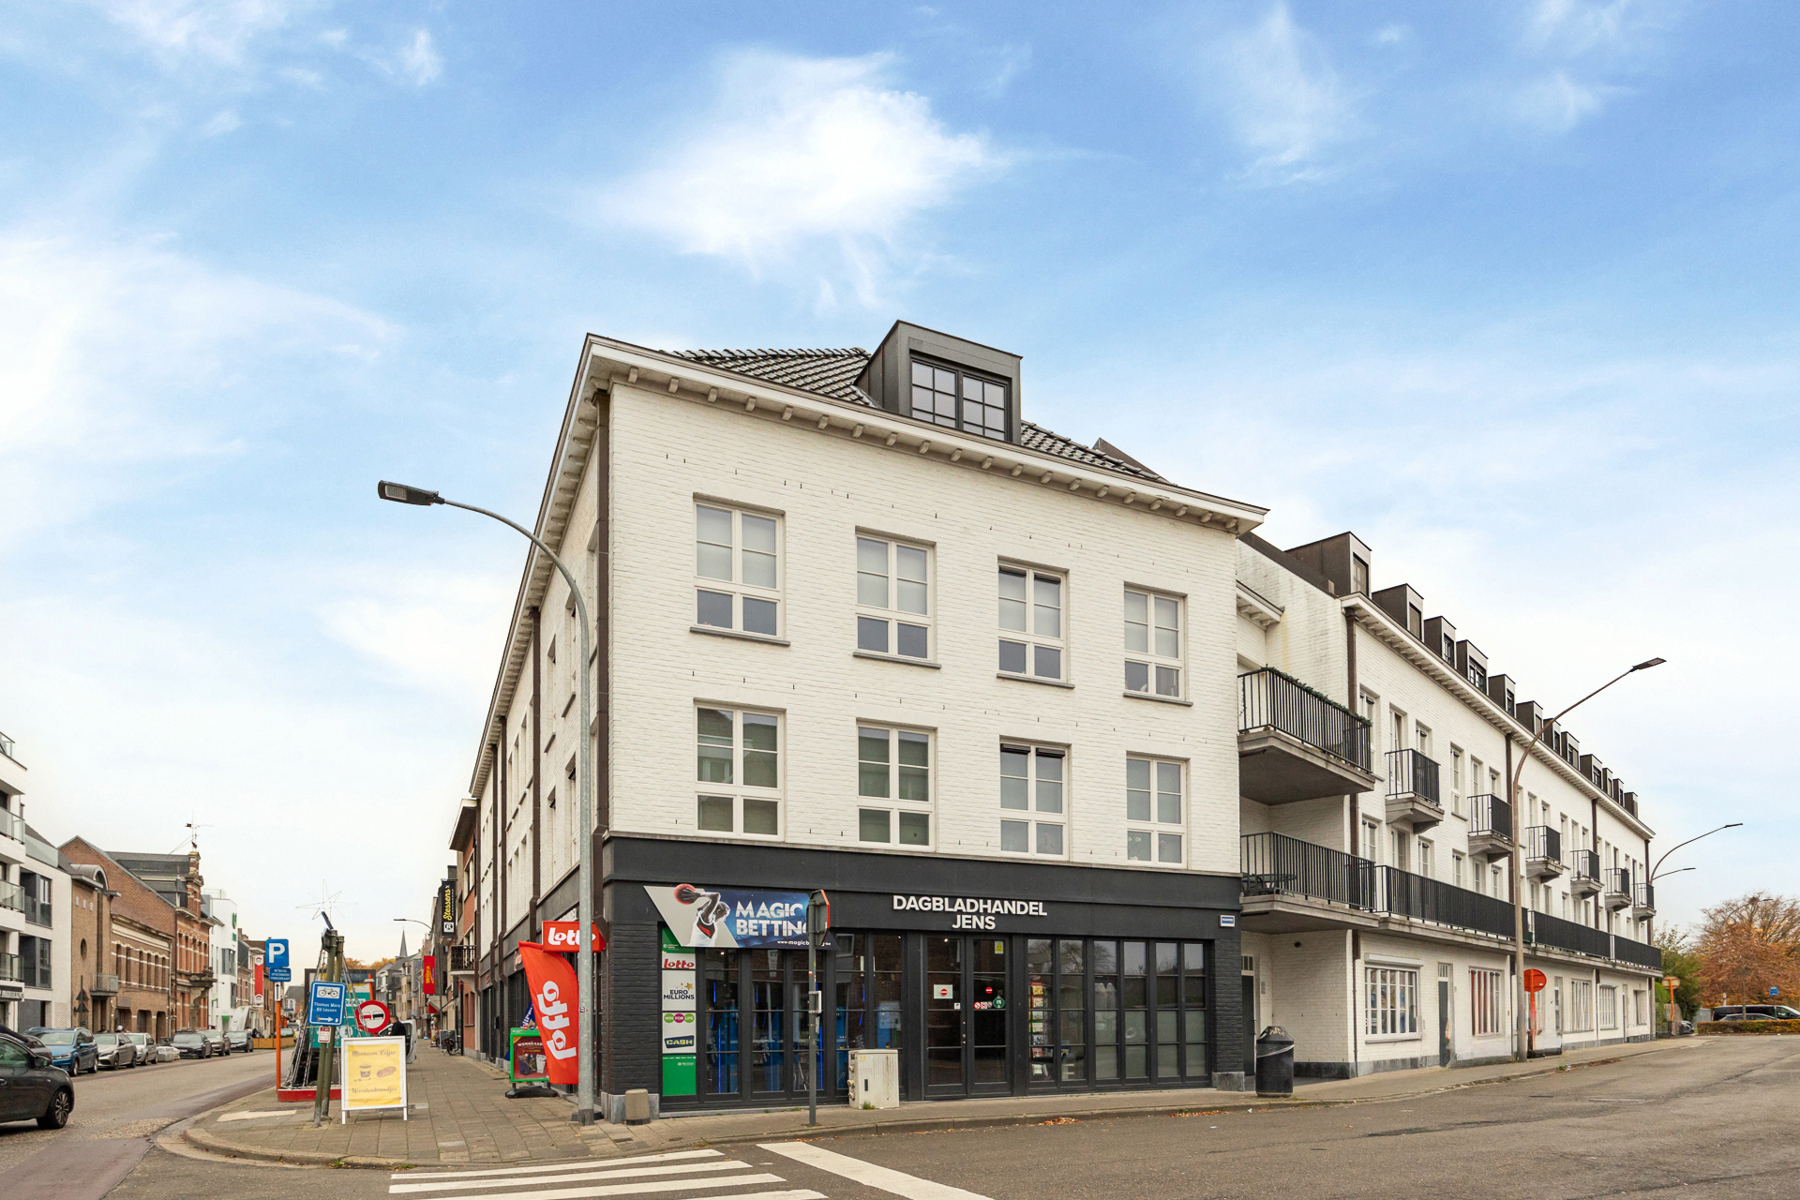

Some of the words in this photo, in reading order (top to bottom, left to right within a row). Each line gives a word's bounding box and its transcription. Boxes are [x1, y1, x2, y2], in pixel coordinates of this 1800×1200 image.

[736, 900, 804, 918] MAGIC
[893, 895, 1048, 916] DAGBLADHANDEL
[736, 919, 806, 936] BETTIN
[952, 914, 996, 930] JENS
[268, 943, 285, 963] P
